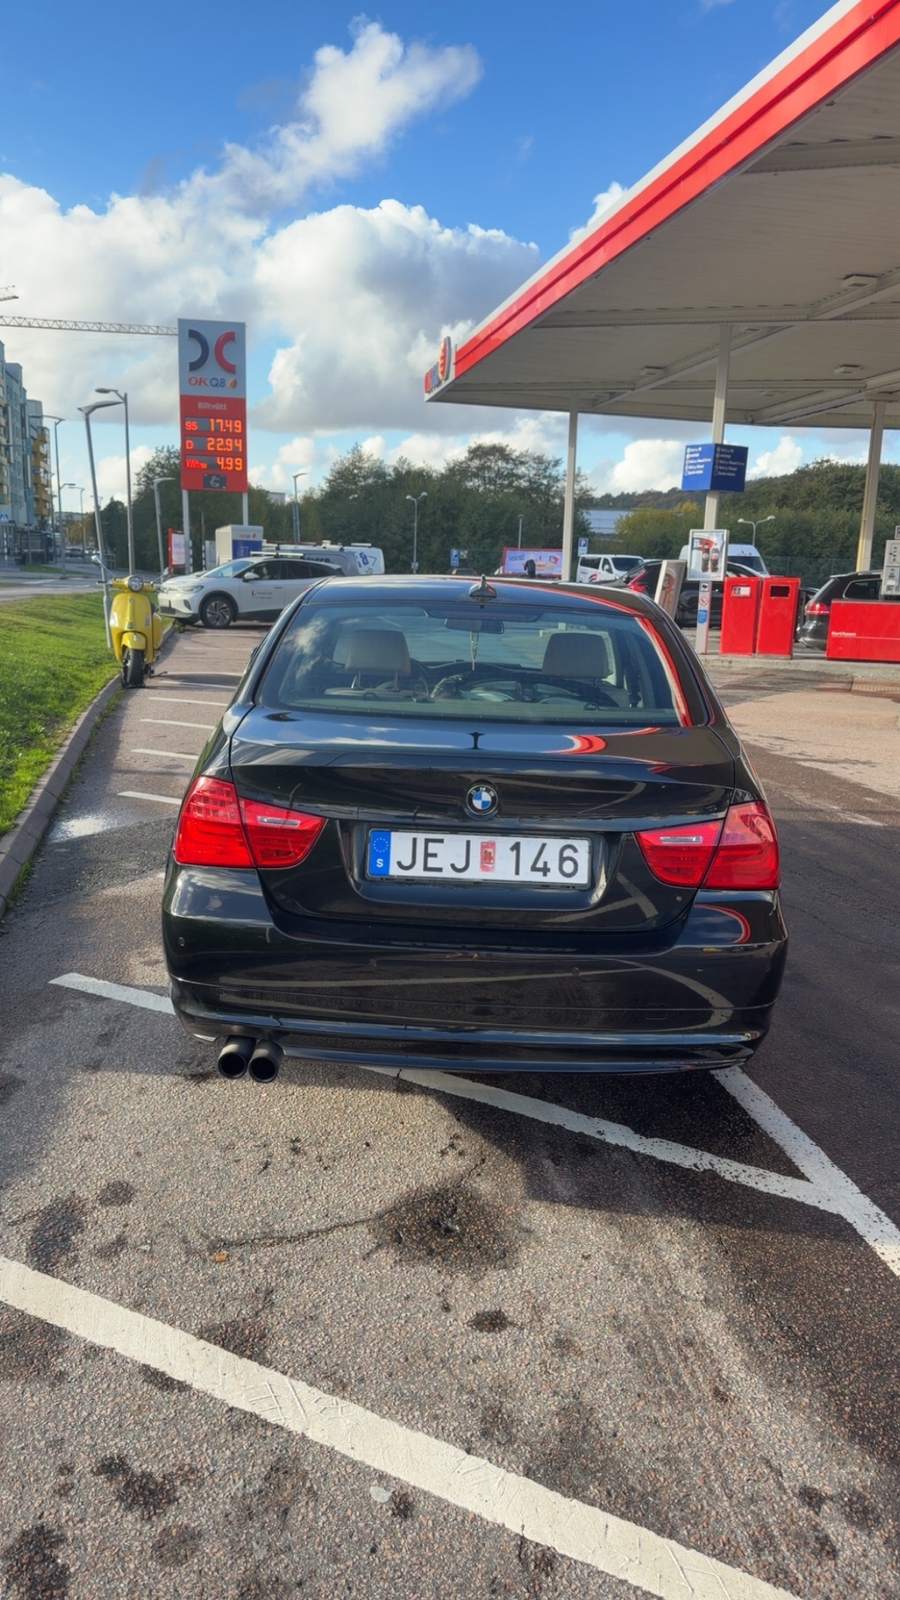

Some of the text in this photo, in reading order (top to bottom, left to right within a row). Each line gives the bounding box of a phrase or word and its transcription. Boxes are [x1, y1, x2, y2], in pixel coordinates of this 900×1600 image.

[185, 418, 242, 433] 95 17.49
[185, 437, 243, 452] D 22.94
[216, 456, 243, 471] 4.99
[376, 837, 579, 879] S JEJ 146
